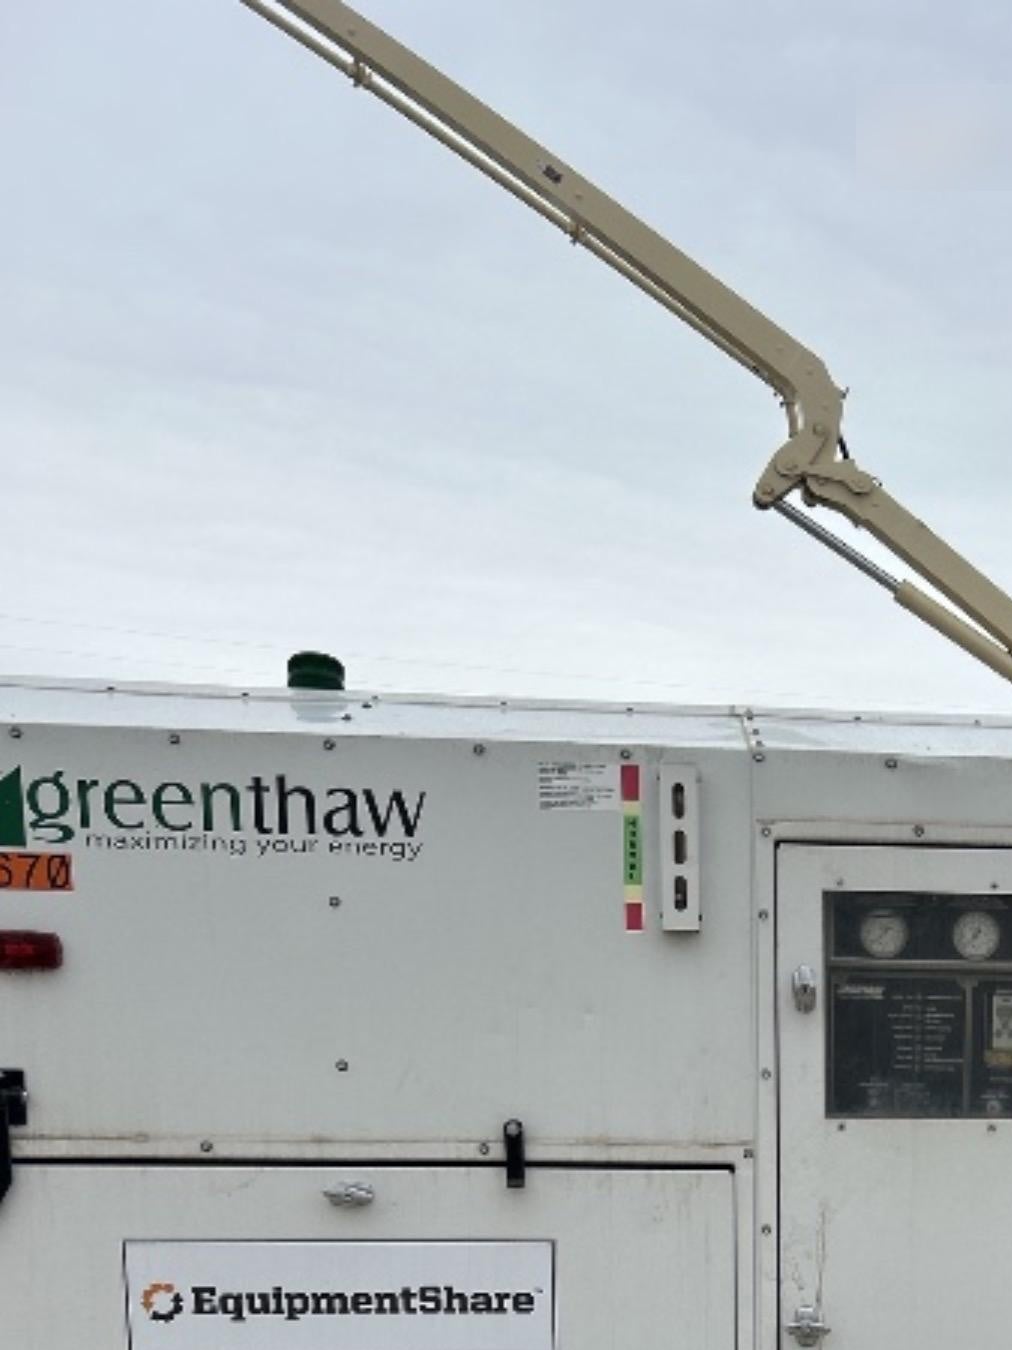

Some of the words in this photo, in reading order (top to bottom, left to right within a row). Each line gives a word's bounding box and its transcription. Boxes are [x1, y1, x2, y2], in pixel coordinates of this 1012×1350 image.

[26, 771, 427, 844] greenthaw
[85, 831, 248, 857] maximizing
[256, 838, 318, 859] your
[328, 839, 423, 862] energy
[191, 1285, 535, 1322] EquipmentShare
